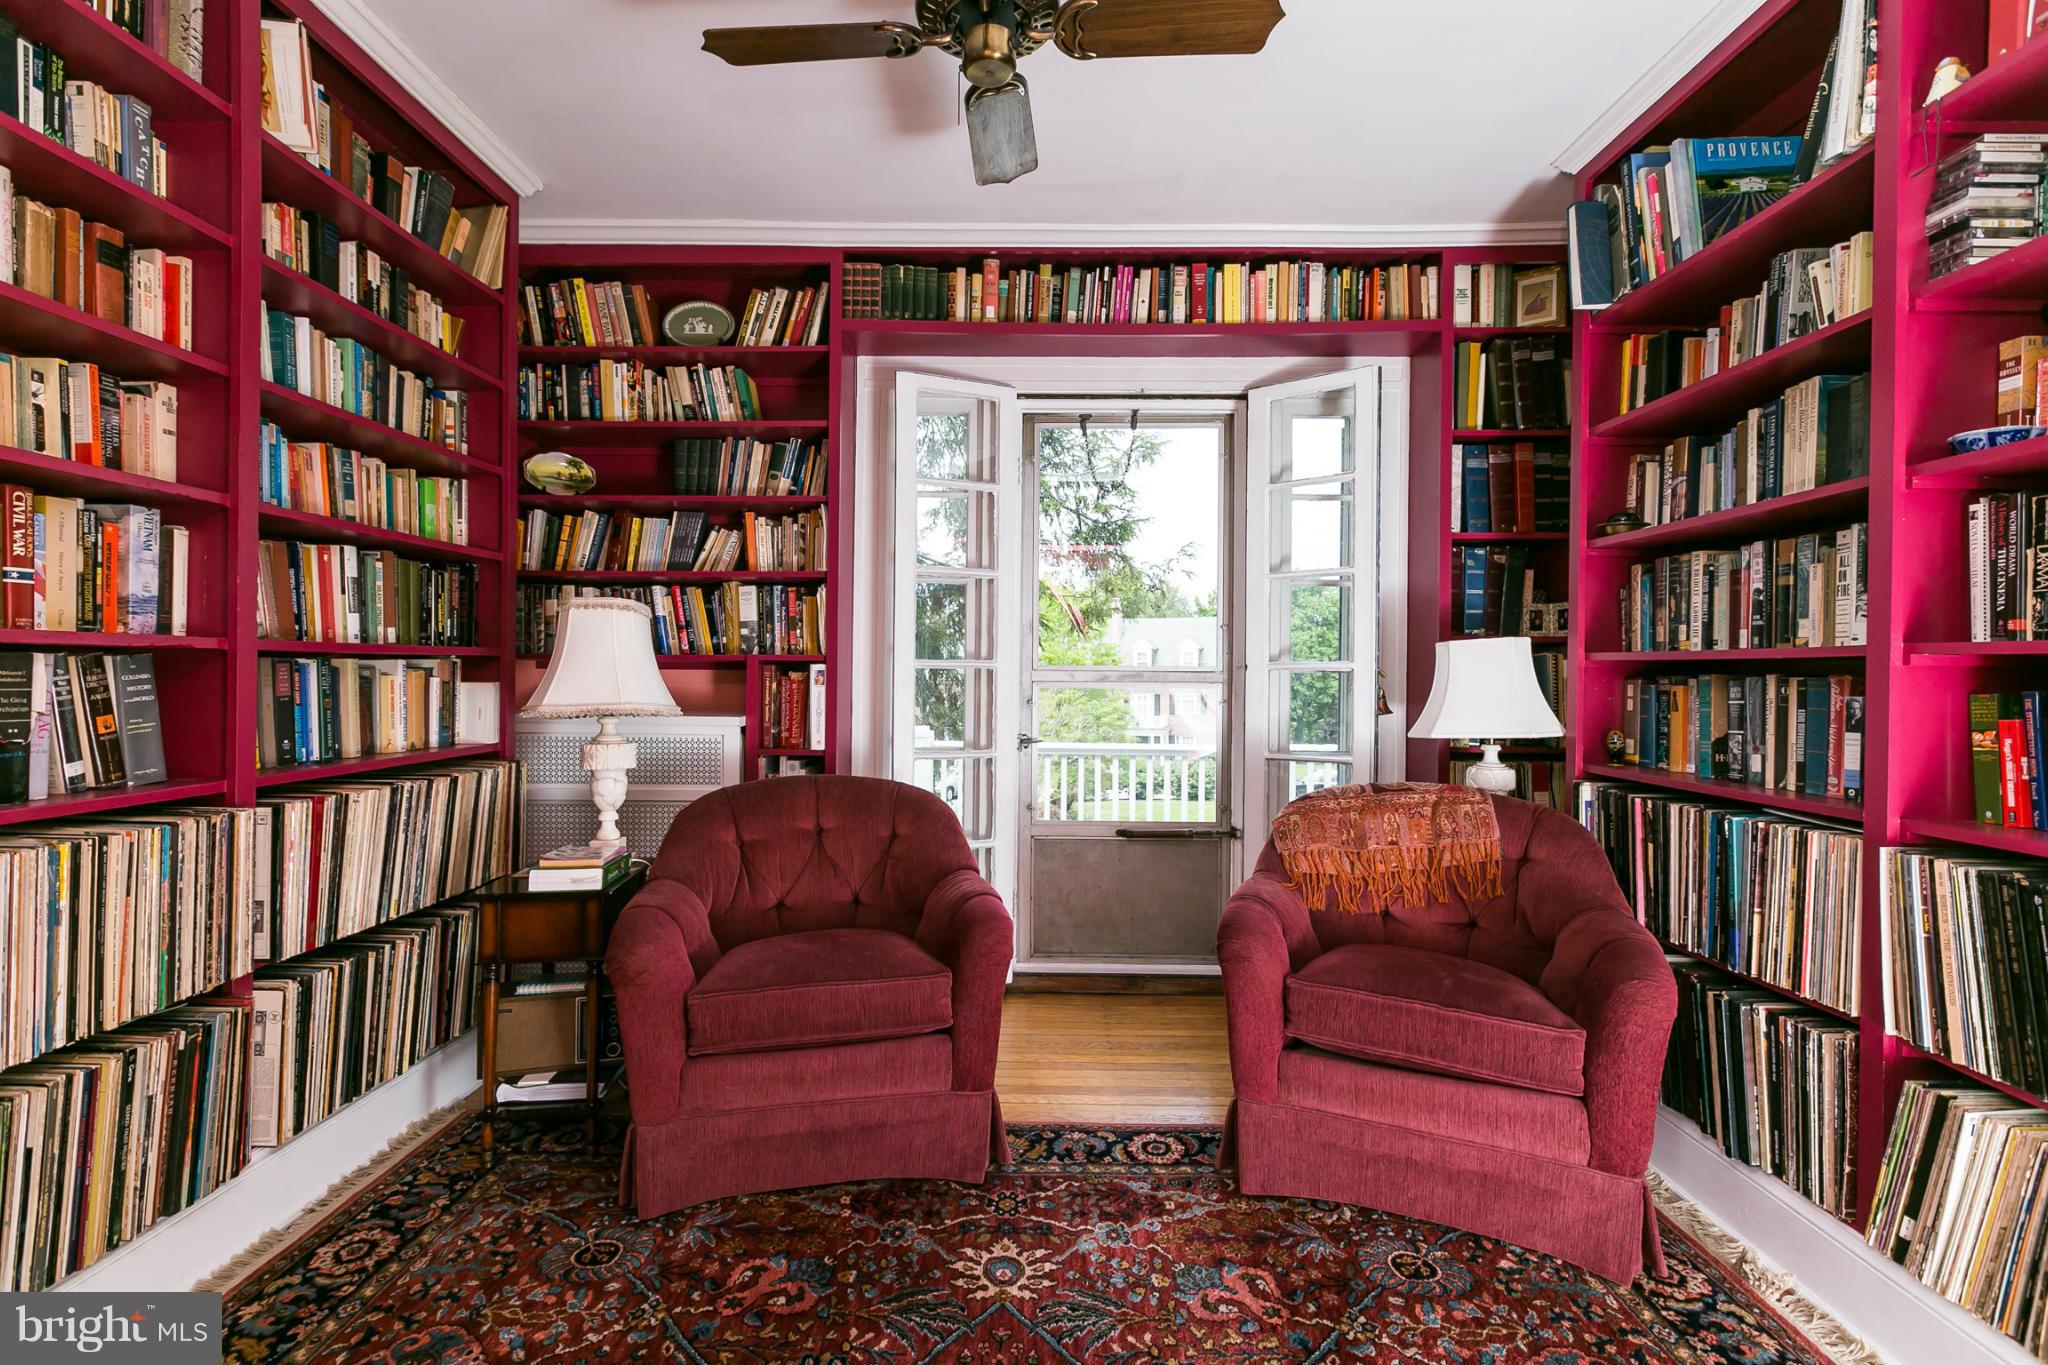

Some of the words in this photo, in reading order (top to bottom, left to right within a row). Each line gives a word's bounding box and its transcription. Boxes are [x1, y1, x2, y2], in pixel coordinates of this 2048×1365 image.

[1706, 140, 1794, 158] PROVENCE
[757, 292, 769, 314] FATSO
[2000, 365, 2021, 377] ODYSSEY
[2006, 360, 2015, 368] THE
[1770, 436, 1776, 446] ME
[12, 491, 26, 527] CIVIL
[143, 512, 155, 552] VIETNAM
[1997, 507, 2006, 537] History
[2008, 510, 2017, 543] WORLD
[13, 529, 26, 556] WAR
[1970, 521, 1979, 552] NOVELS
[1839, 554, 1850, 568] ALL
[1997, 547, 2006, 571] THE
[2008, 545, 2017, 577] DRAMA
[2036, 545, 2048, 590] DRAMA
[1838, 569, 1847, 583] ON
[1971, 570, 1979, 589] FILM
[85, 581, 94, 620] NIGHTMARE
[1837, 584, 1850, 597] FIRE
[1996, 572, 2006, 612] CINEMA
[1658, 694, 1668, 734] SINCLAIR
[2004, 738, 2013, 761] Roget's
